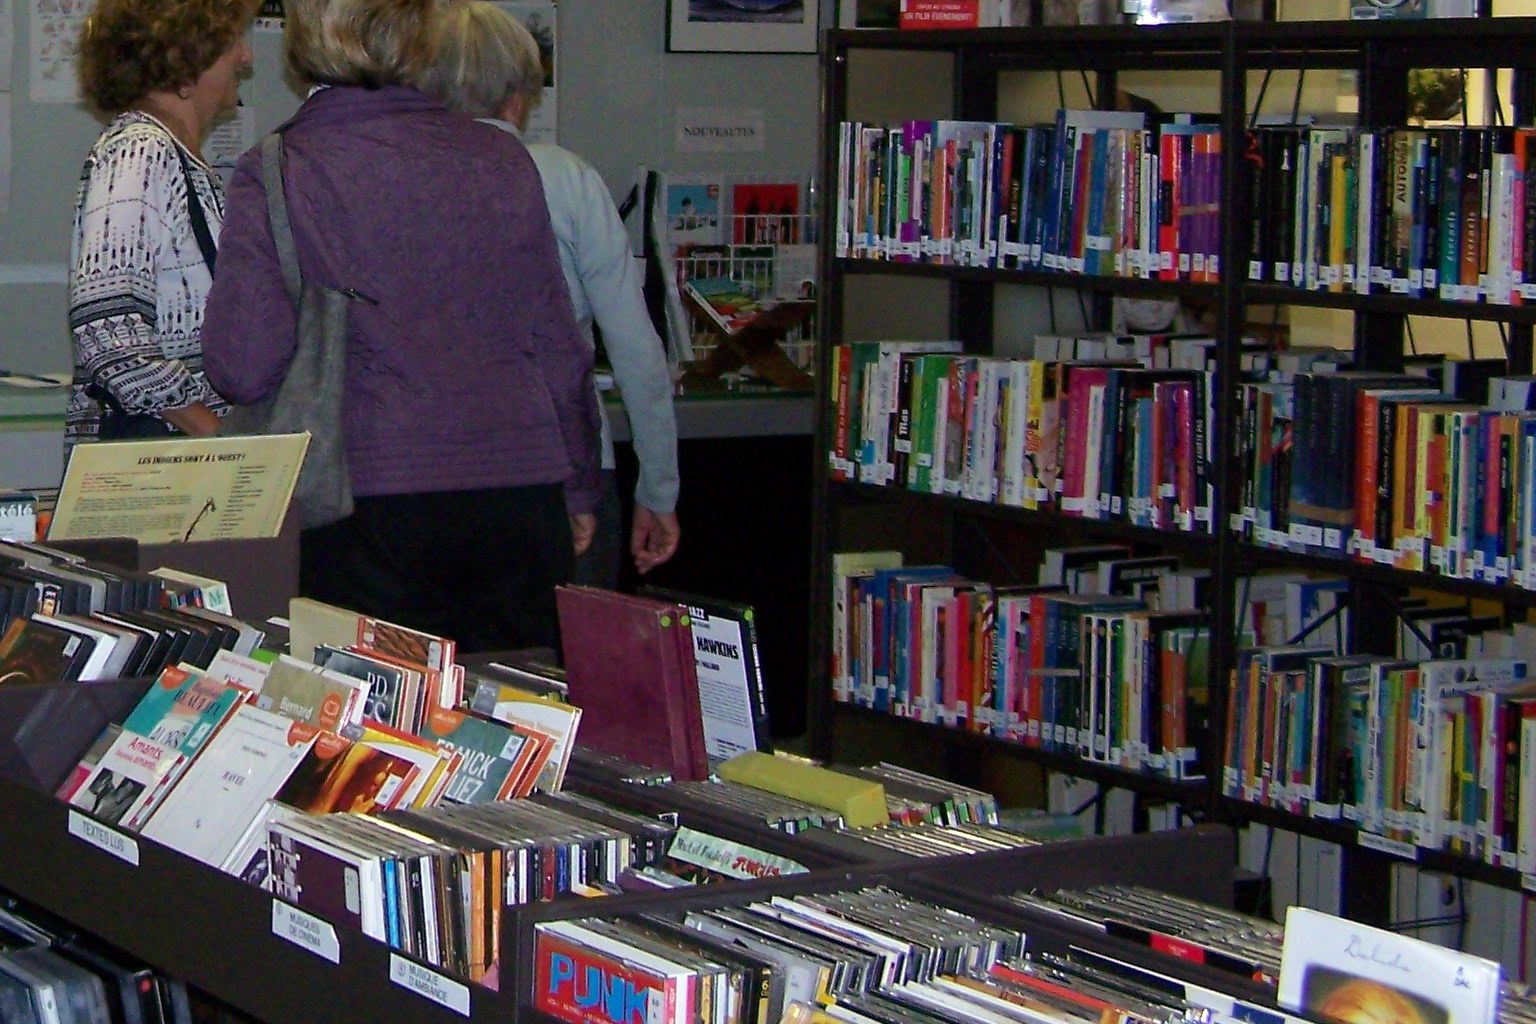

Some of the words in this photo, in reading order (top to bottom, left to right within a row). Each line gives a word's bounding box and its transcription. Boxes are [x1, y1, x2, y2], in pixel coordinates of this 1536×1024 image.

[0, 503, 34, 517] télé
[696, 636, 739, 660] HAWKINS
[82, 820, 109, 846] TEXTES
[108, 833, 124, 852] LUS
[289, 912, 321, 936] MUSIQUES
[289, 924, 297, 937] DE
[1343, 934, 1411, 973] Dalida
[408, 963, 440, 987] MUSIQUE
[408, 976, 448, 1004] D'AMBIANCE
[549, 951, 649, 1024] PUNK
